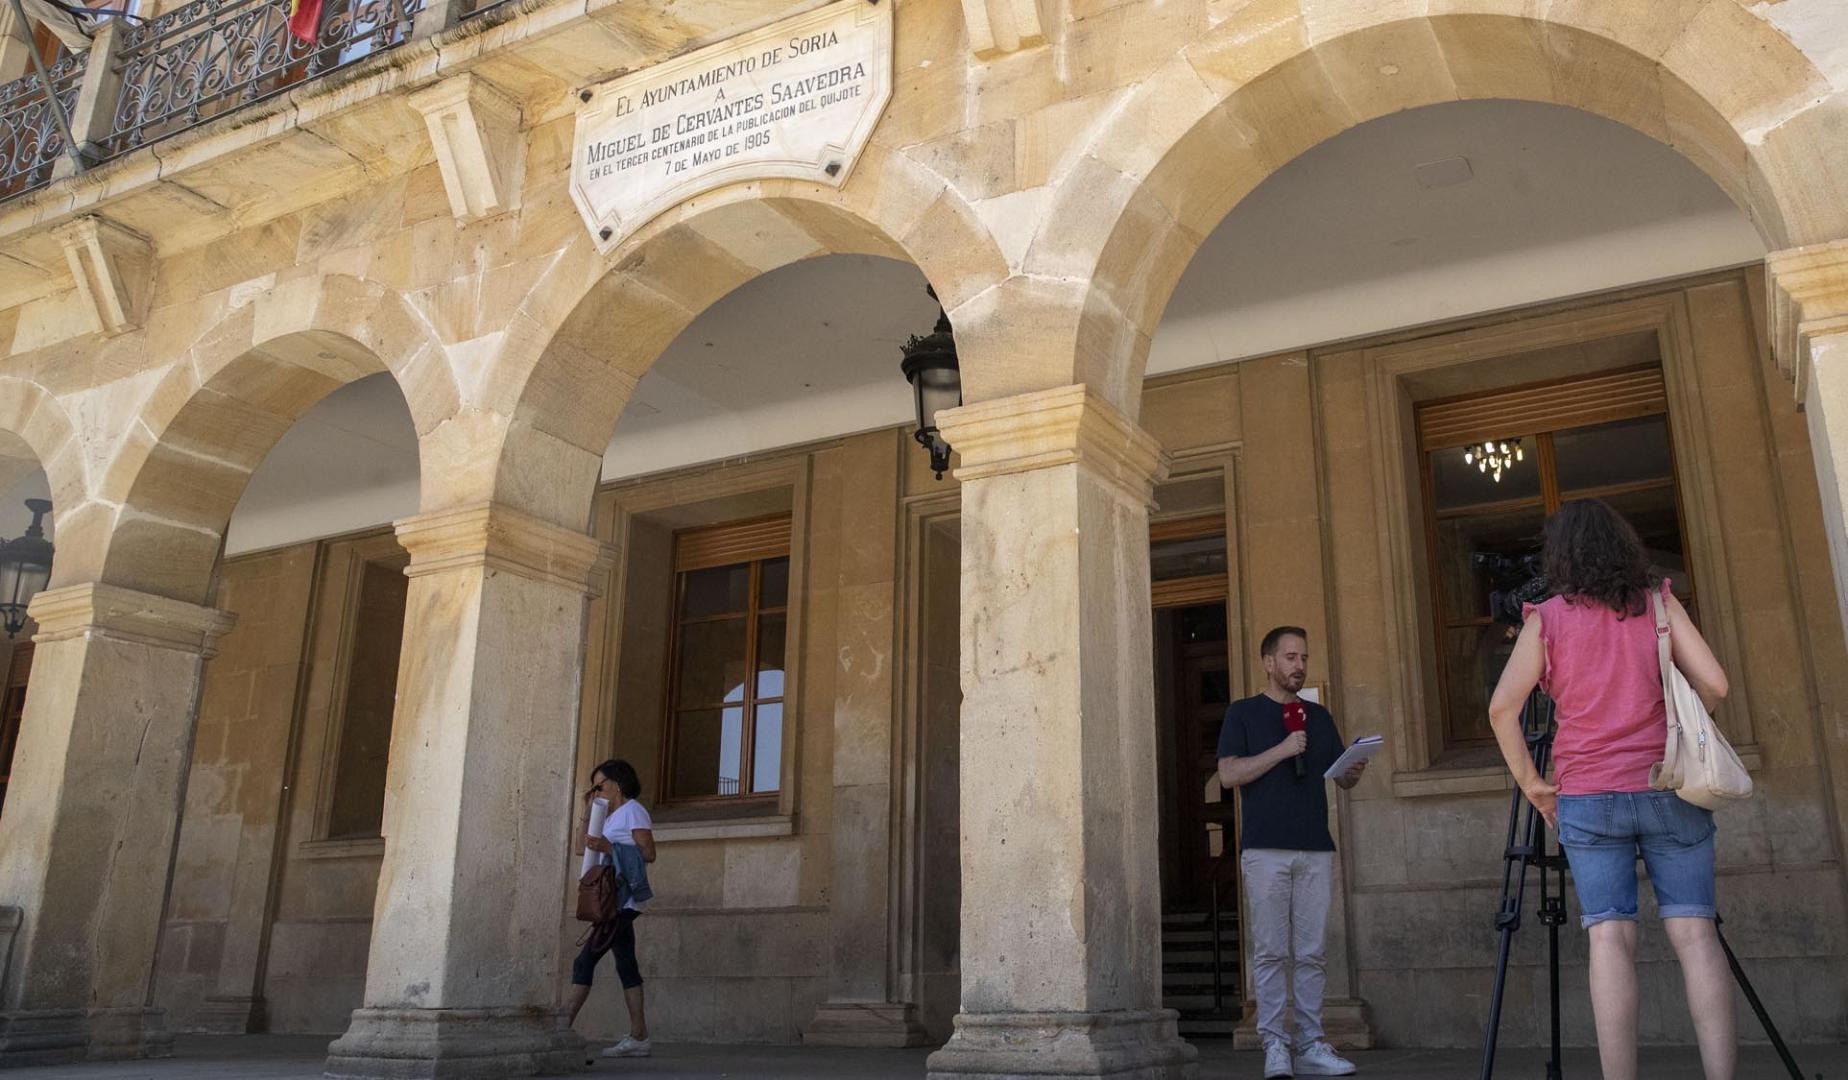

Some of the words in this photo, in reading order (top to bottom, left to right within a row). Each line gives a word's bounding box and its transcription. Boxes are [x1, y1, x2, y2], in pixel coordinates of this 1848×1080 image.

[587, 133, 646, 165] MIGUEL
[652, 123, 671, 144] DE
[676, 93, 764, 136] CERVANTES
[771, 62, 866, 104] SAAVEDRA
[616, 96, 634, 117] EL
[640, 57, 756, 110] AYUNTAMIENTO
[761, 47, 783, 69] DE
[788, 31, 839, 59] SORIA
[714, 87, 726, 102] A
[589, 168, 601, 180] EN
[603, 164, 614, 176] EL
[616, 151, 649, 171] TERCER
[651, 133, 705, 160] CENTENARIO
[707, 129, 719, 142] DE
[722, 125, 733, 137] LA
[736, 104, 796, 133] PUBLICACION
[799, 100, 817, 114] DEL
[820, 85, 861, 108] QUIJOTE
[665, 161, 672, 175] 7
[674, 159, 688, 173] DE
[692, 148, 721, 167] MAYO
[725, 143, 740, 156] DE
[744, 129, 770, 151] 1905
